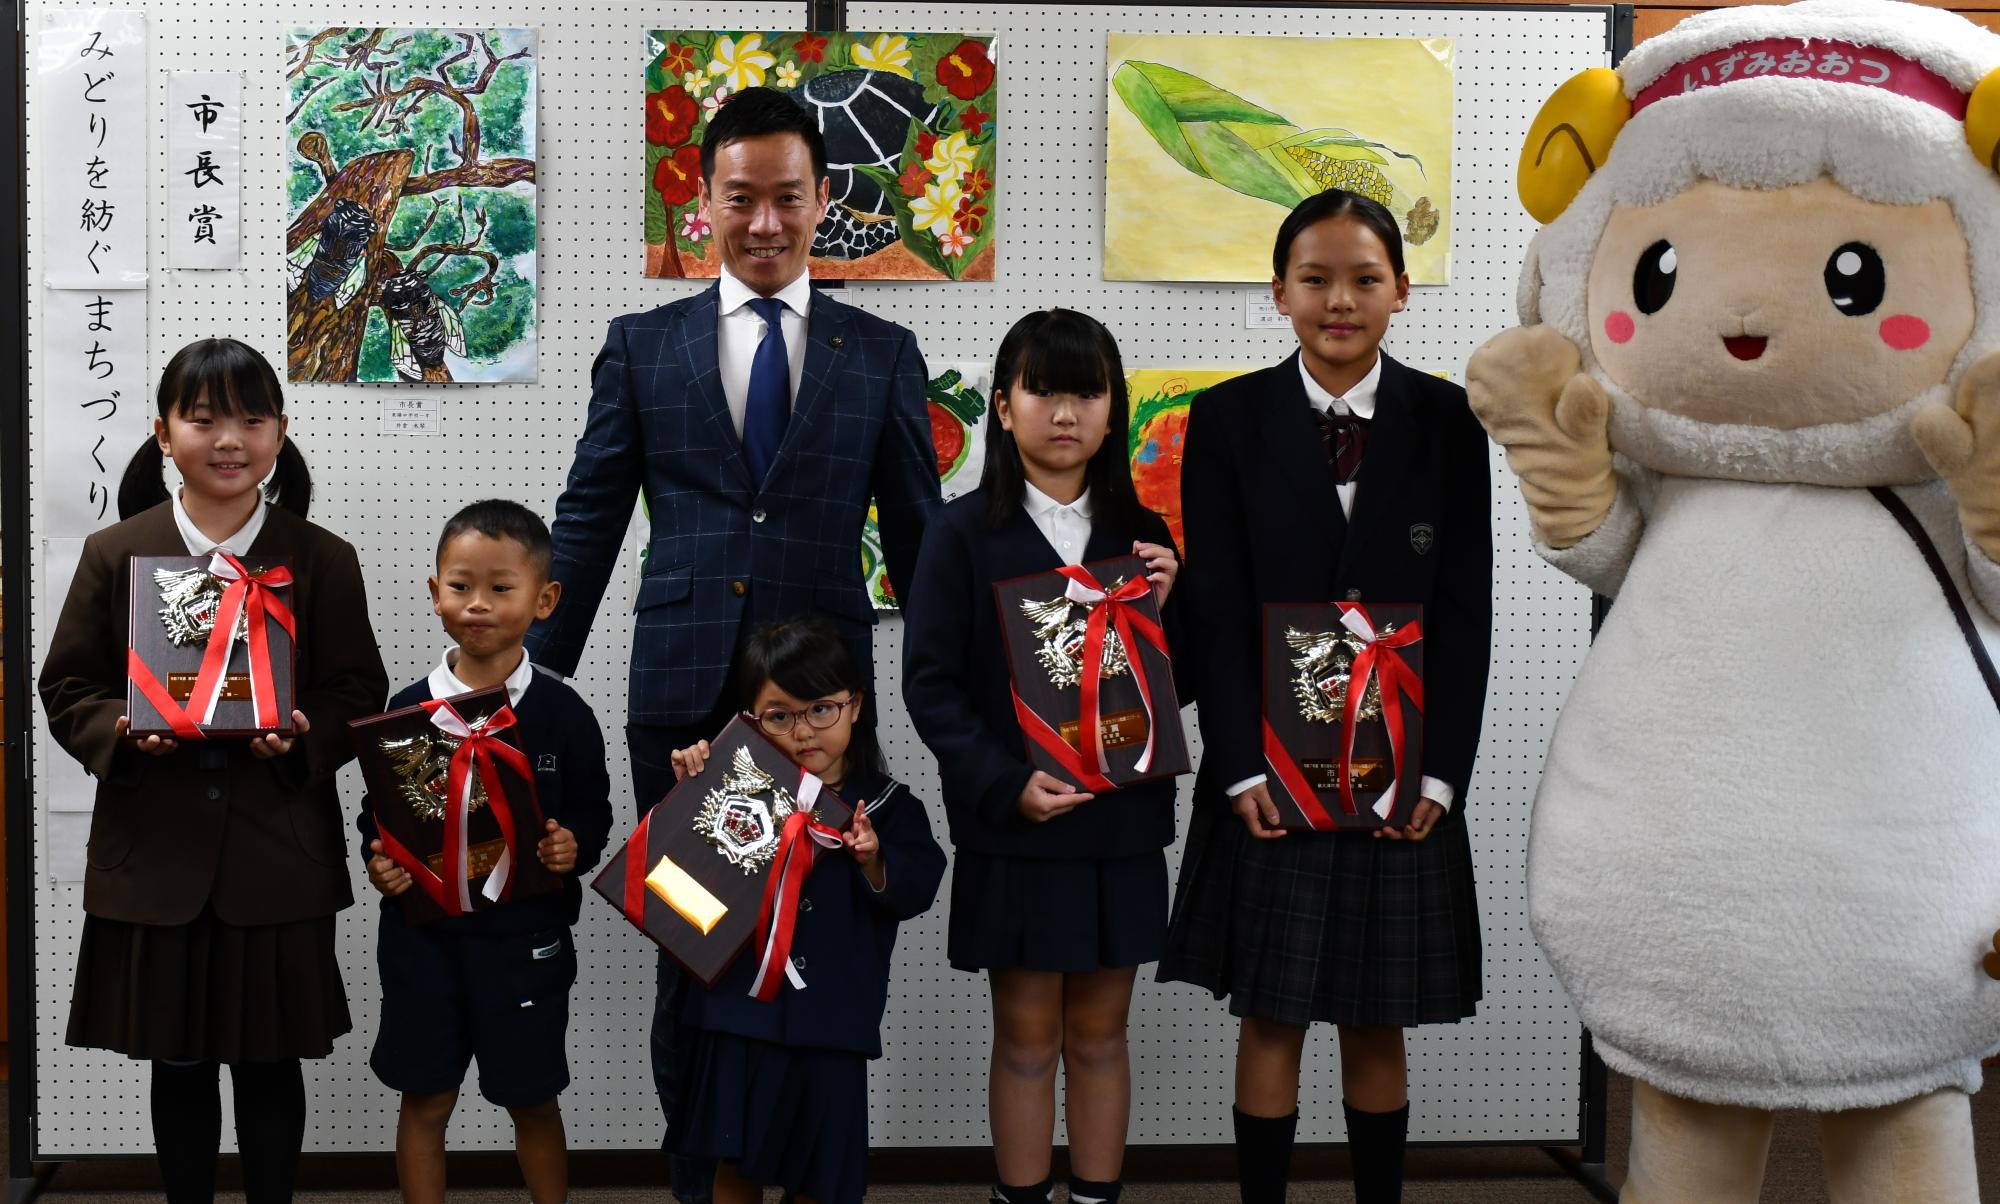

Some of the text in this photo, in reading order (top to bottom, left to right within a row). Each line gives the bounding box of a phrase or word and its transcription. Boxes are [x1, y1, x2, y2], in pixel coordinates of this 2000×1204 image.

[1683, 49, 1891, 92] いずみおおつ
[184, 95, 224, 245] 市長賞
[80, 31, 118, 521] みどりを紡ぐまちづくり
